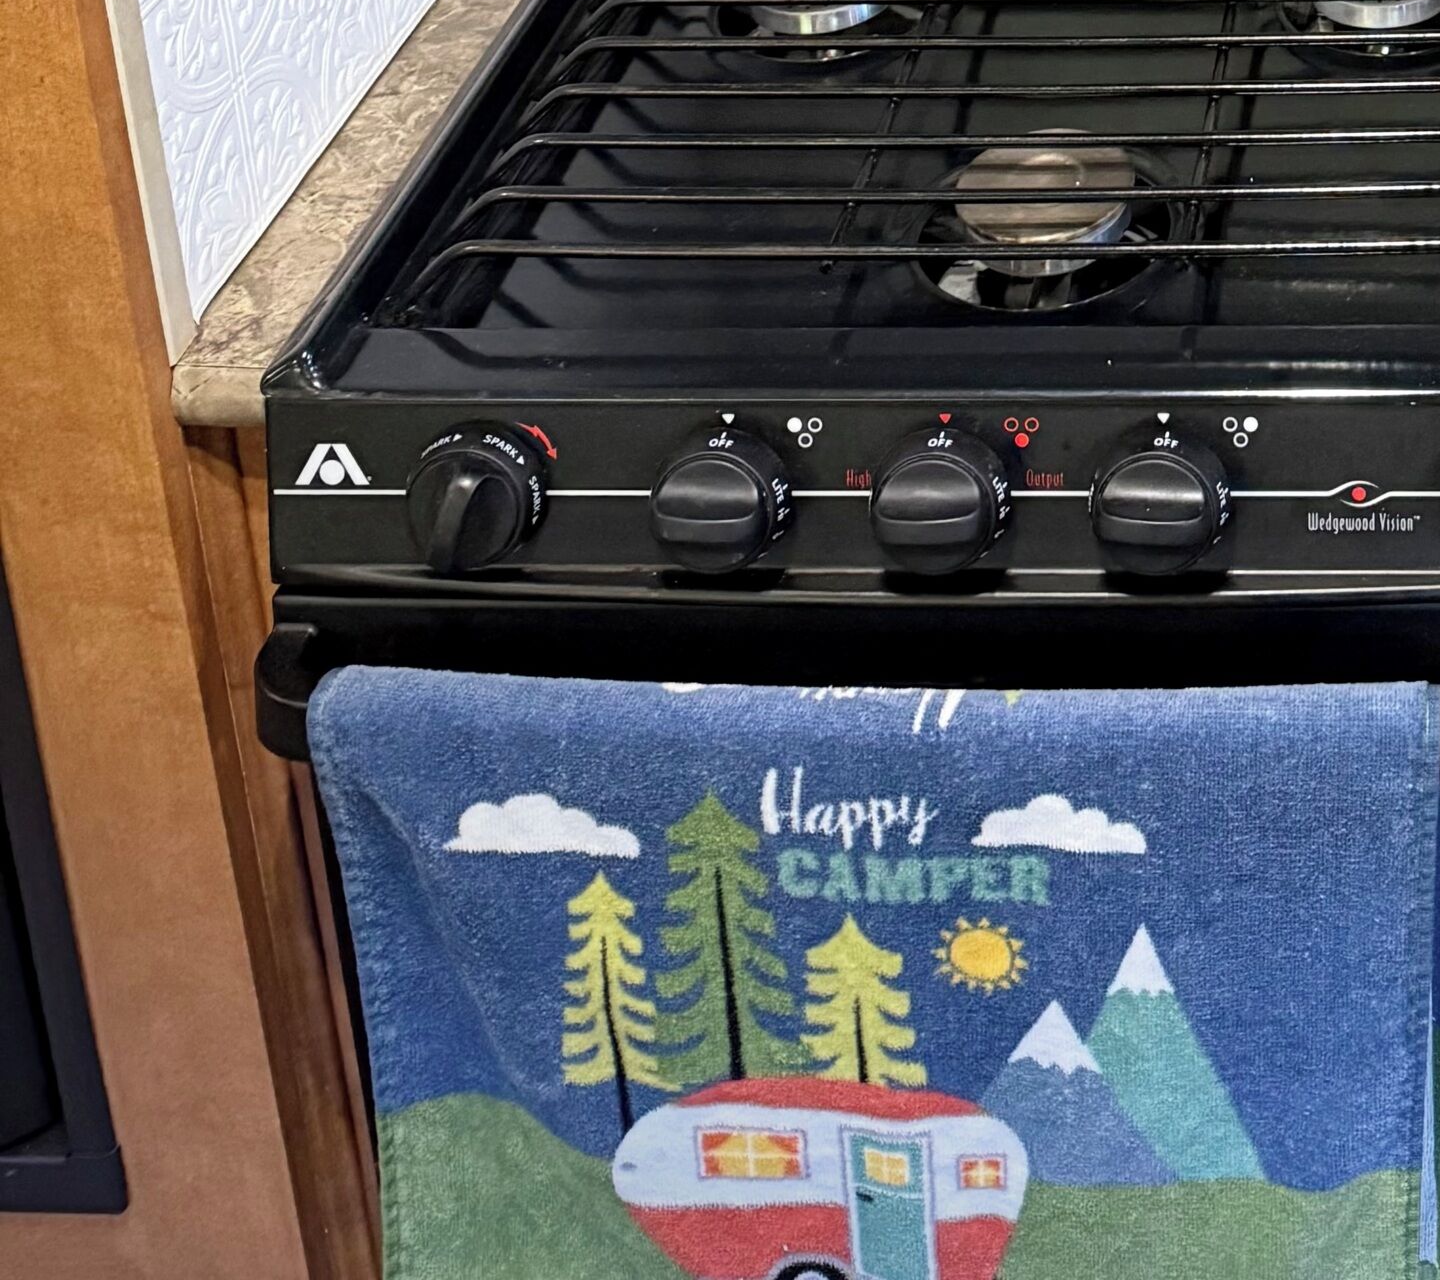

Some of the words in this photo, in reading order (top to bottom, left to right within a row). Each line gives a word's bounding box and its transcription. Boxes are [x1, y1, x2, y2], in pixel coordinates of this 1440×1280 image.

[483, 434, 519, 459] SPARK
[708, 438, 734, 449] OFF
[927, 438, 953, 448] OFF
[1153, 437, 1179, 449] OFF
[846, 469, 872, 488] High
[1026, 468, 1065, 487] Output
[528, 475, 541, 515] SPARK
[1307, 512, 1376, 535] Wedgewood
[761, 766, 939, 851] Happy
[776, 848, 1052, 906] CAMPER
